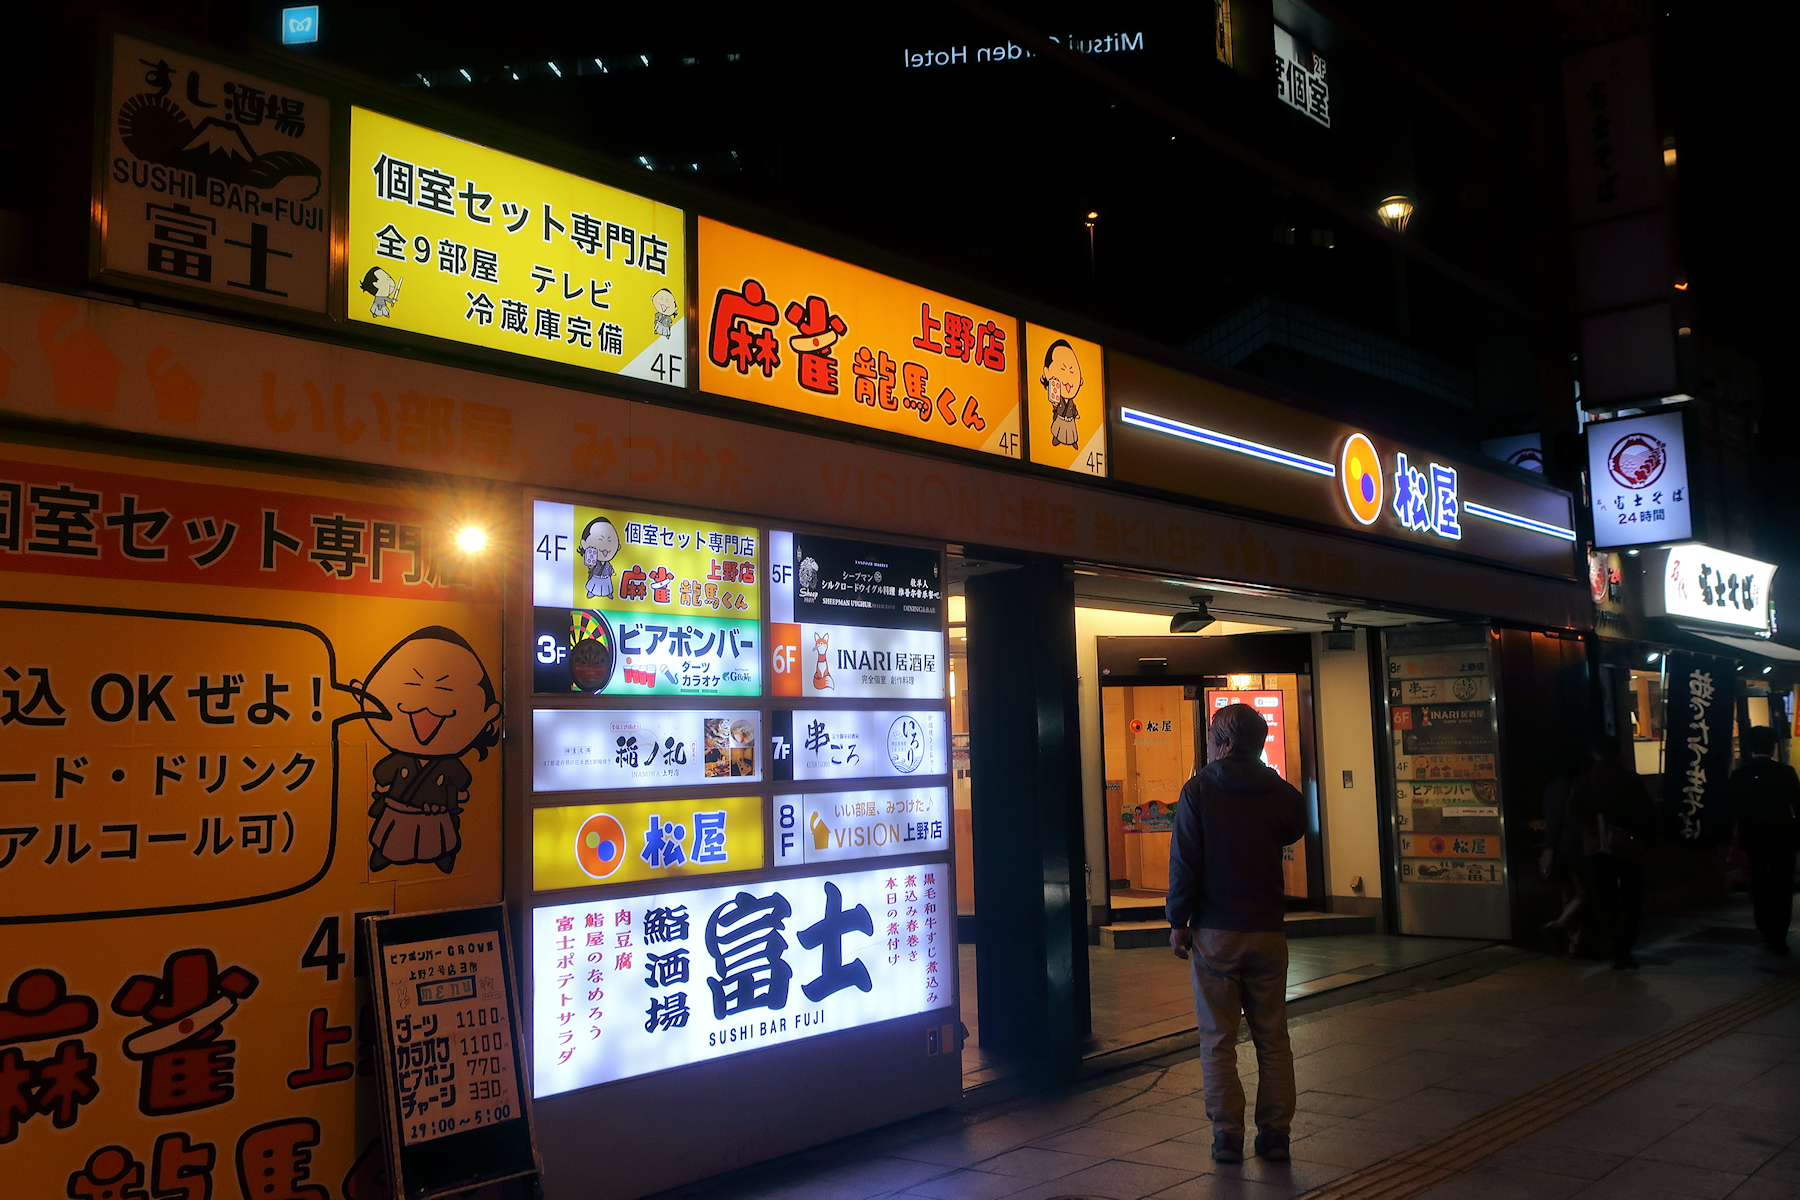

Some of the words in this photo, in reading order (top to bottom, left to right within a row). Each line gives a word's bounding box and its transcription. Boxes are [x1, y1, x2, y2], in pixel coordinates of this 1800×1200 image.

[139, 59, 305, 139] すし酒場
[113, 157, 193, 200] SUSHI
[373, 152, 670, 277] 個室セット専門店
[146, 202, 293, 298] 富士
[374, 223, 499, 285] 全9部屋
[530, 264, 613, 311] テレビ
[465, 288, 624, 357] 冷蔵庫完備
[912, 302, 1007, 373] 上野店
[650, 353, 683, 384] 4F
[707, 279, 848, 396] 麻雀
[852, 347, 987, 432] 龍馬くん
[998, 431, 1018, 457] 4F
[1086, 451, 1103, 475] 4F
[820, 462, 981, 534] VISION
[1393, 452, 1462, 541] 松屋
[1613, 487, 1686, 511] 富士そば
[1618, 508, 1666, 525] 24時間
[536, 534, 569, 562] 4F
[624, 521, 756, 558] 個室セット専門店
[619, 564, 676, 604] 麻雀
[679, 579, 749, 611] 龍馬くん
[706, 558, 756, 584] 上野店
[772, 563, 792, 584] 5F
[822, 597, 851, 607] SHEEPMAN
[537, 635, 568, 666] 3F
[618, 622, 754, 659] ビアポンバー
[681, 660, 711, 674] ダーツ
[772, 645, 797, 674] 6F
[837, 649, 892, 671] INARI
[895, 652, 936, 673] 居酒屋
[1, 666, 67, 727] 込
[90, 674, 176, 724] OK
[187, 673, 324, 725] ぜよ!
[682, 674, 721, 687] カラオケ
[1146, 720, 1172, 732] 松屋
[1393, 711, 1410, 724] 6F
[1430, 710, 1460, 720] INARI
[771, 737, 791, 761] 7F
[902, 720, 920, 769] いろり
[1396, 762, 1409, 772] 4F
[639, 809, 729, 869] 松屋
[779, 804, 795, 857] 8F
[834, 822, 900, 848] VISION
[903, 820, 943, 842] 上野店
[1452, 838, 1487, 854] 松屋
[885, 877, 901, 967] 本日の煮付け
[904, 874, 920, 963] 煮込み春巻き
[447, 941, 494, 957] GROVE
[614, 909, 634, 972] 肉豆腐
[704, 881, 874, 1021] 富士
[922, 872, 940, 1004] 黒毛和牛すじ煮込み
[584, 912, 605, 1042] 鮨屋のなめろう
[643, 904, 691, 1034] 鮨酒場
[555, 915, 576, 1066] 富士ポテトサラダ
[396, 1014, 438, 1044] ダーツ
[709, 1025, 755, 1048] SUSHI
[760, 1018, 787, 1038] BAR
[795, 1009, 826, 1029] FUJI
[397, 1036, 451, 1071] カラオケ
